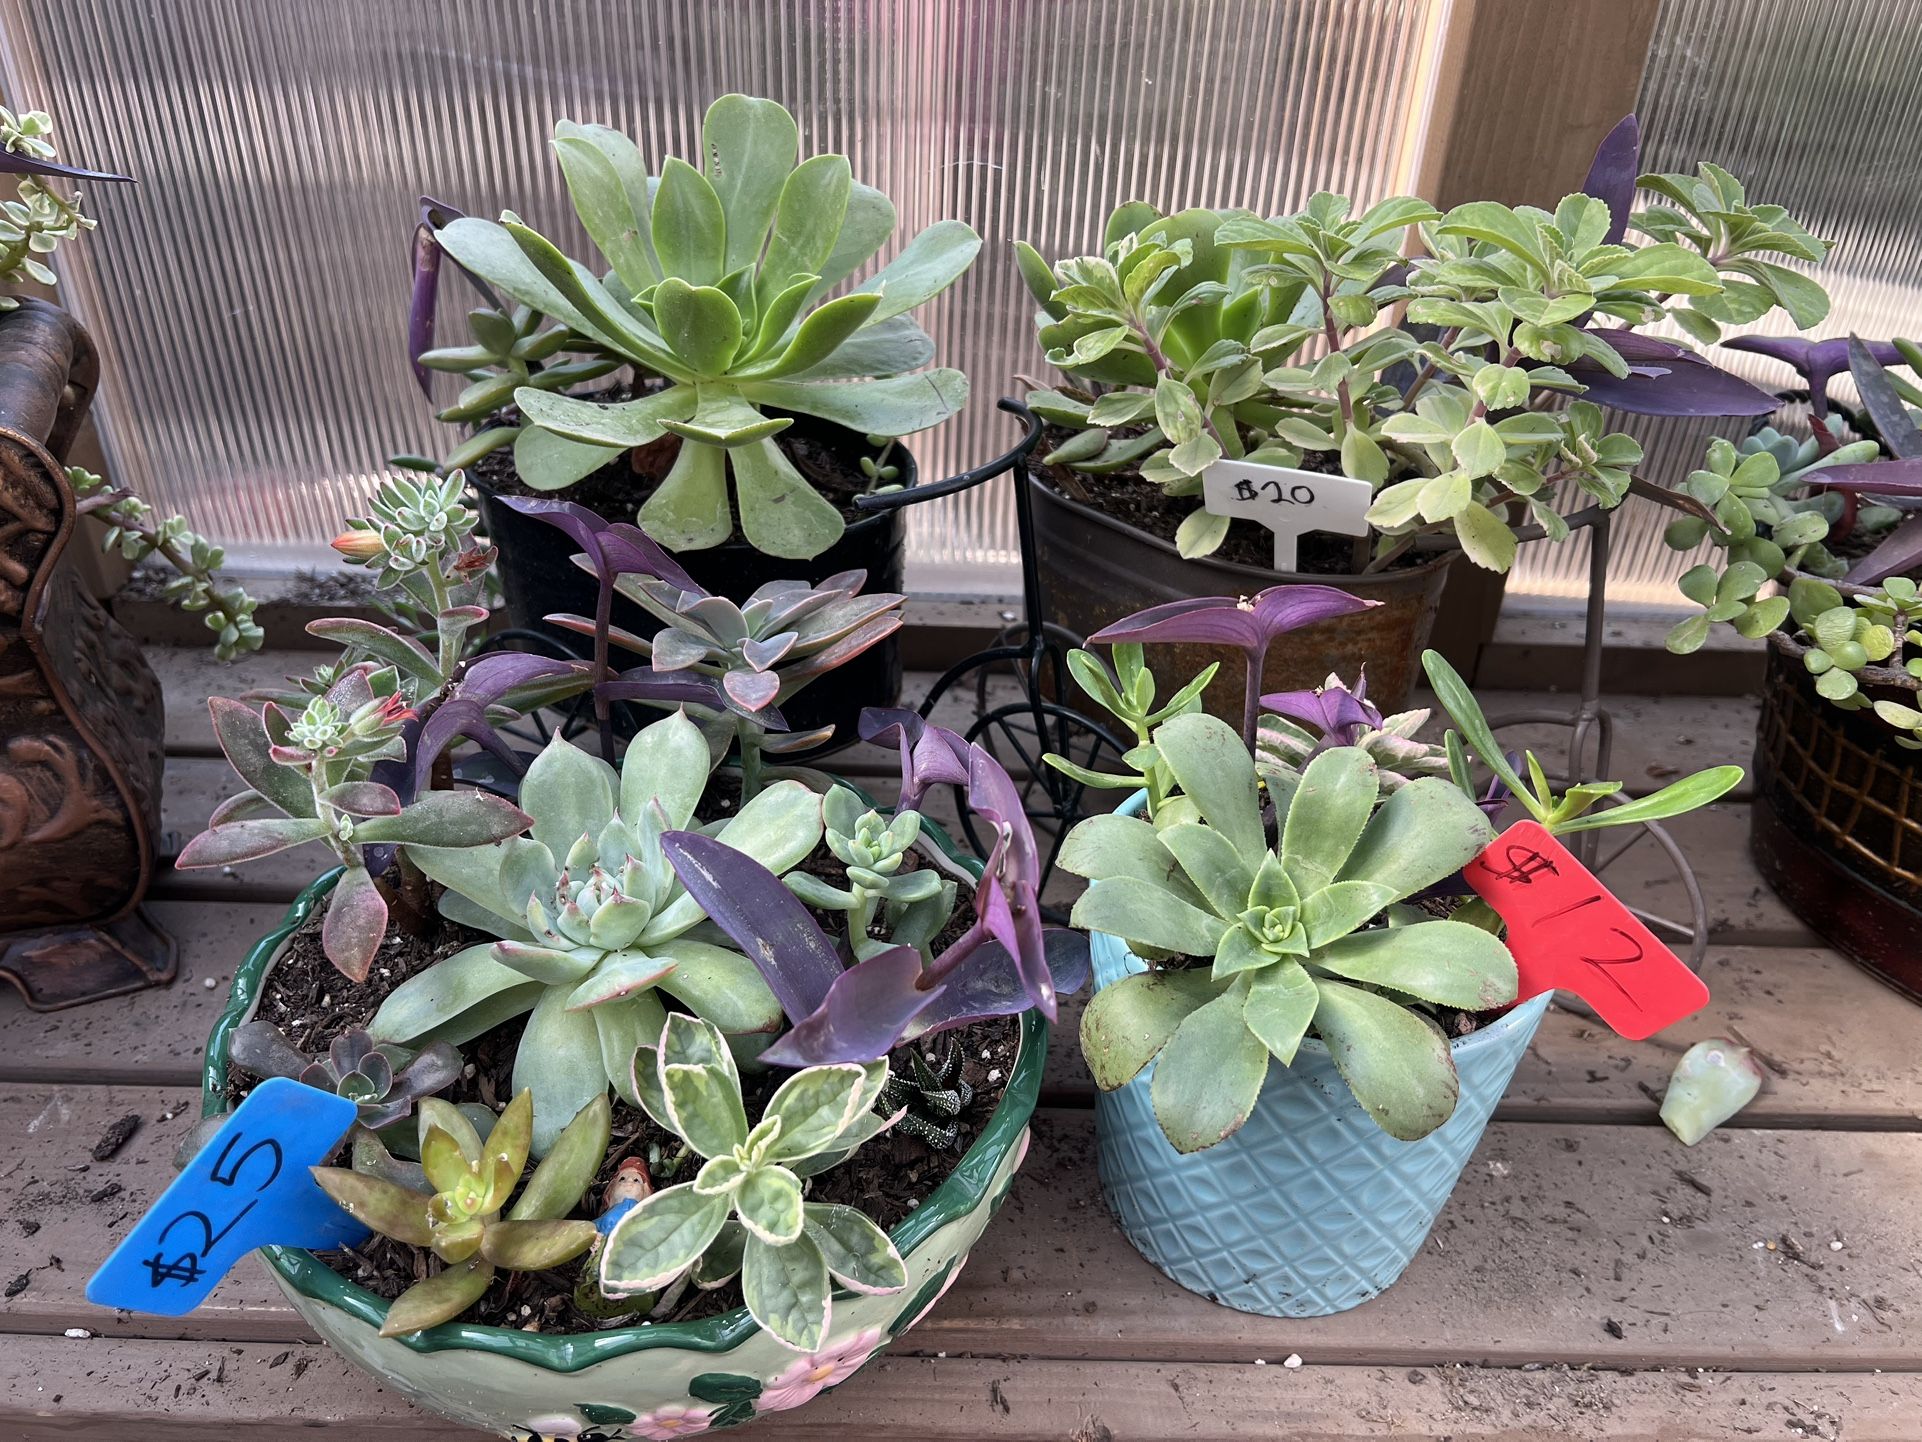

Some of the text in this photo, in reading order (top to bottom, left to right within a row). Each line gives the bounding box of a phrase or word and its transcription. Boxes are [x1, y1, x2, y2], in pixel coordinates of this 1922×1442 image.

[1233, 478, 1315, 505] $20
[1479, 844, 1644, 1012] $12
[142, 1131, 283, 1288] $25
